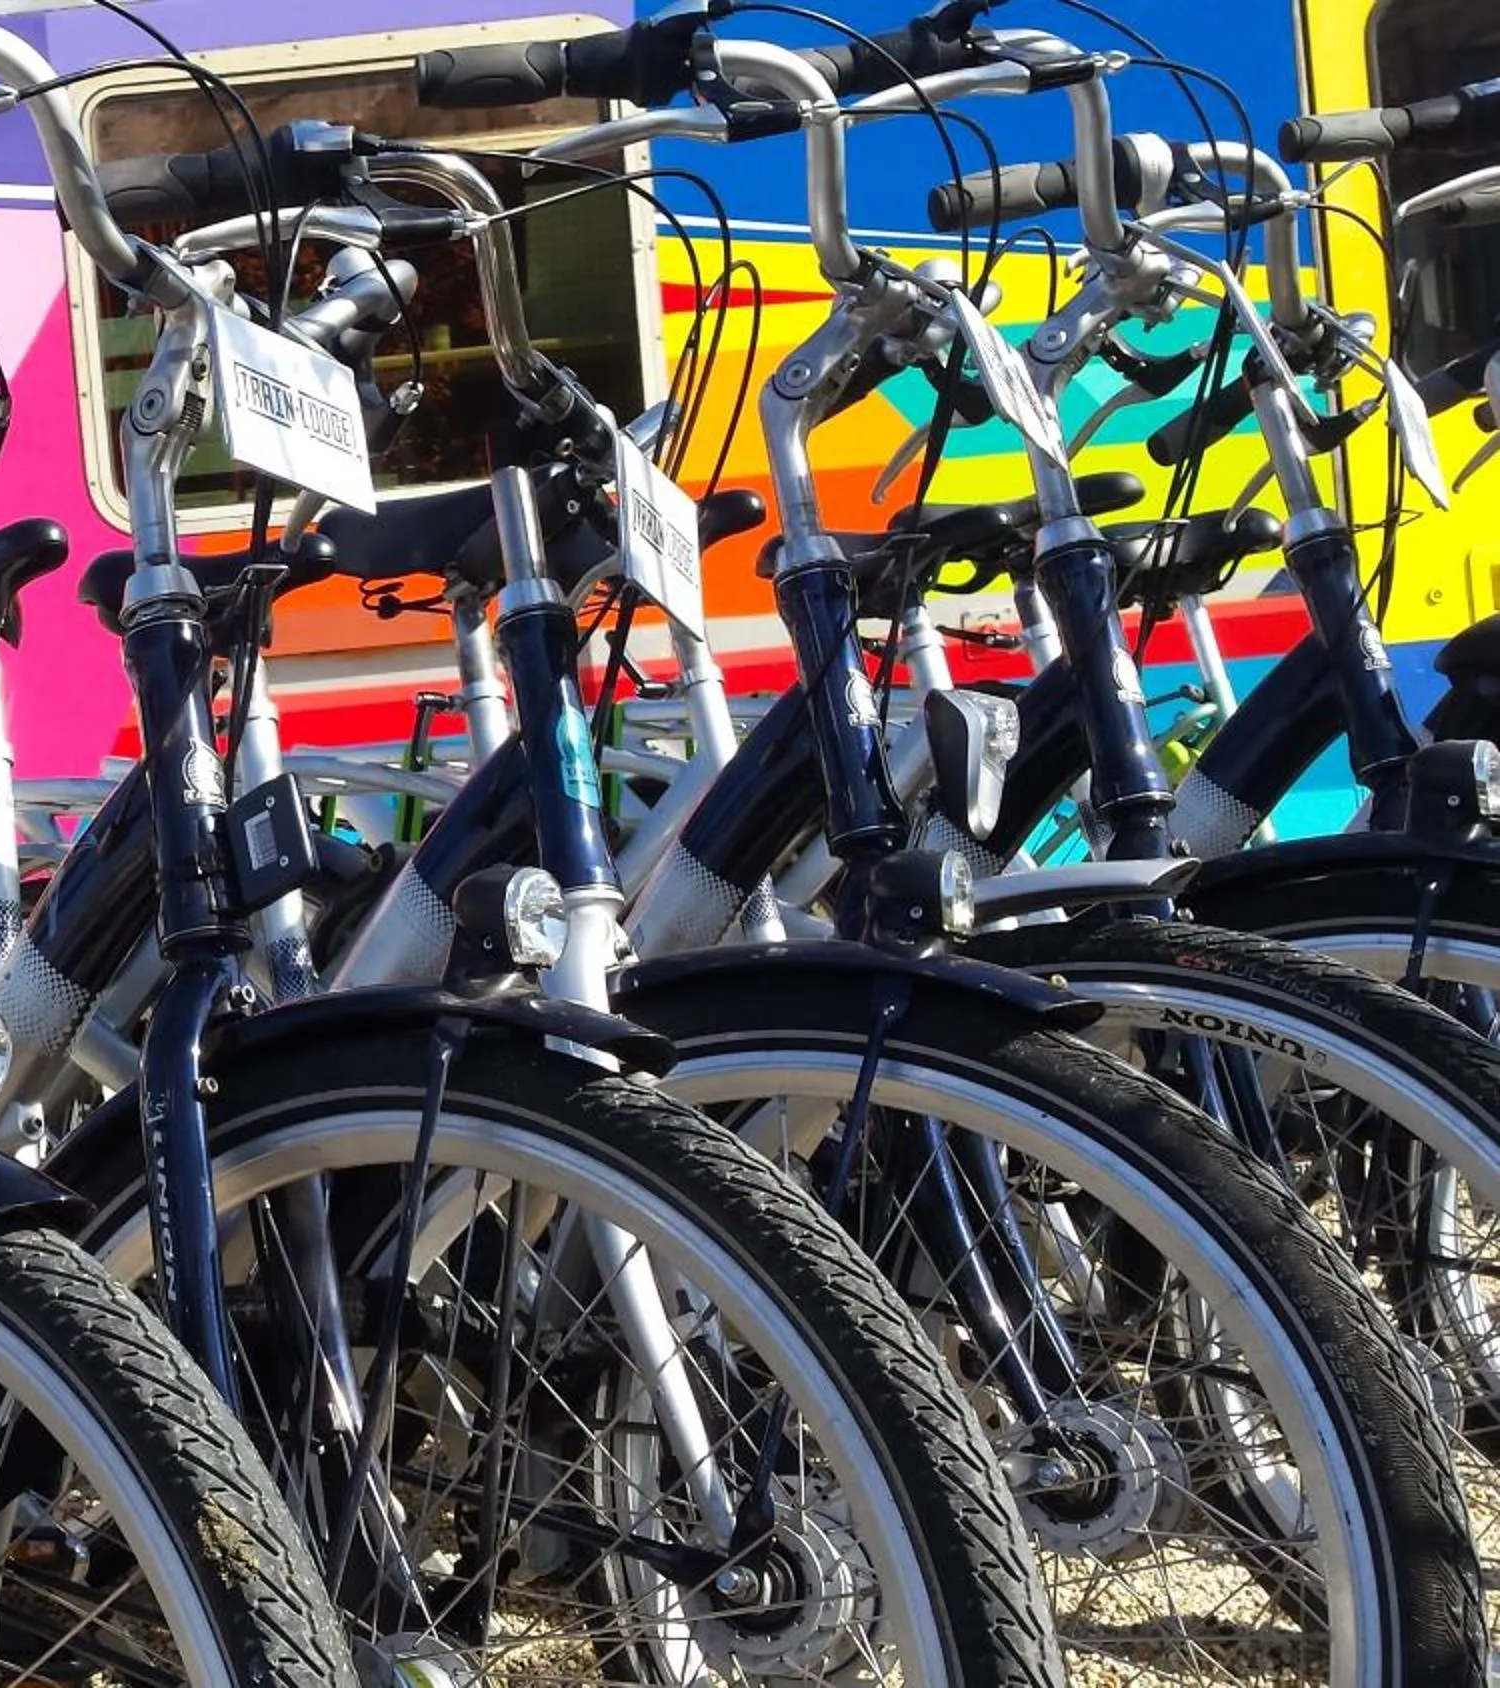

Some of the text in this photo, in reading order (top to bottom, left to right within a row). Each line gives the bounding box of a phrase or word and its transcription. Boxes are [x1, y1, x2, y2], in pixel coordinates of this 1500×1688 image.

[240, 371, 352, 447] TRAIN LODGE
[1160, 1006, 1307, 1062] UNION
